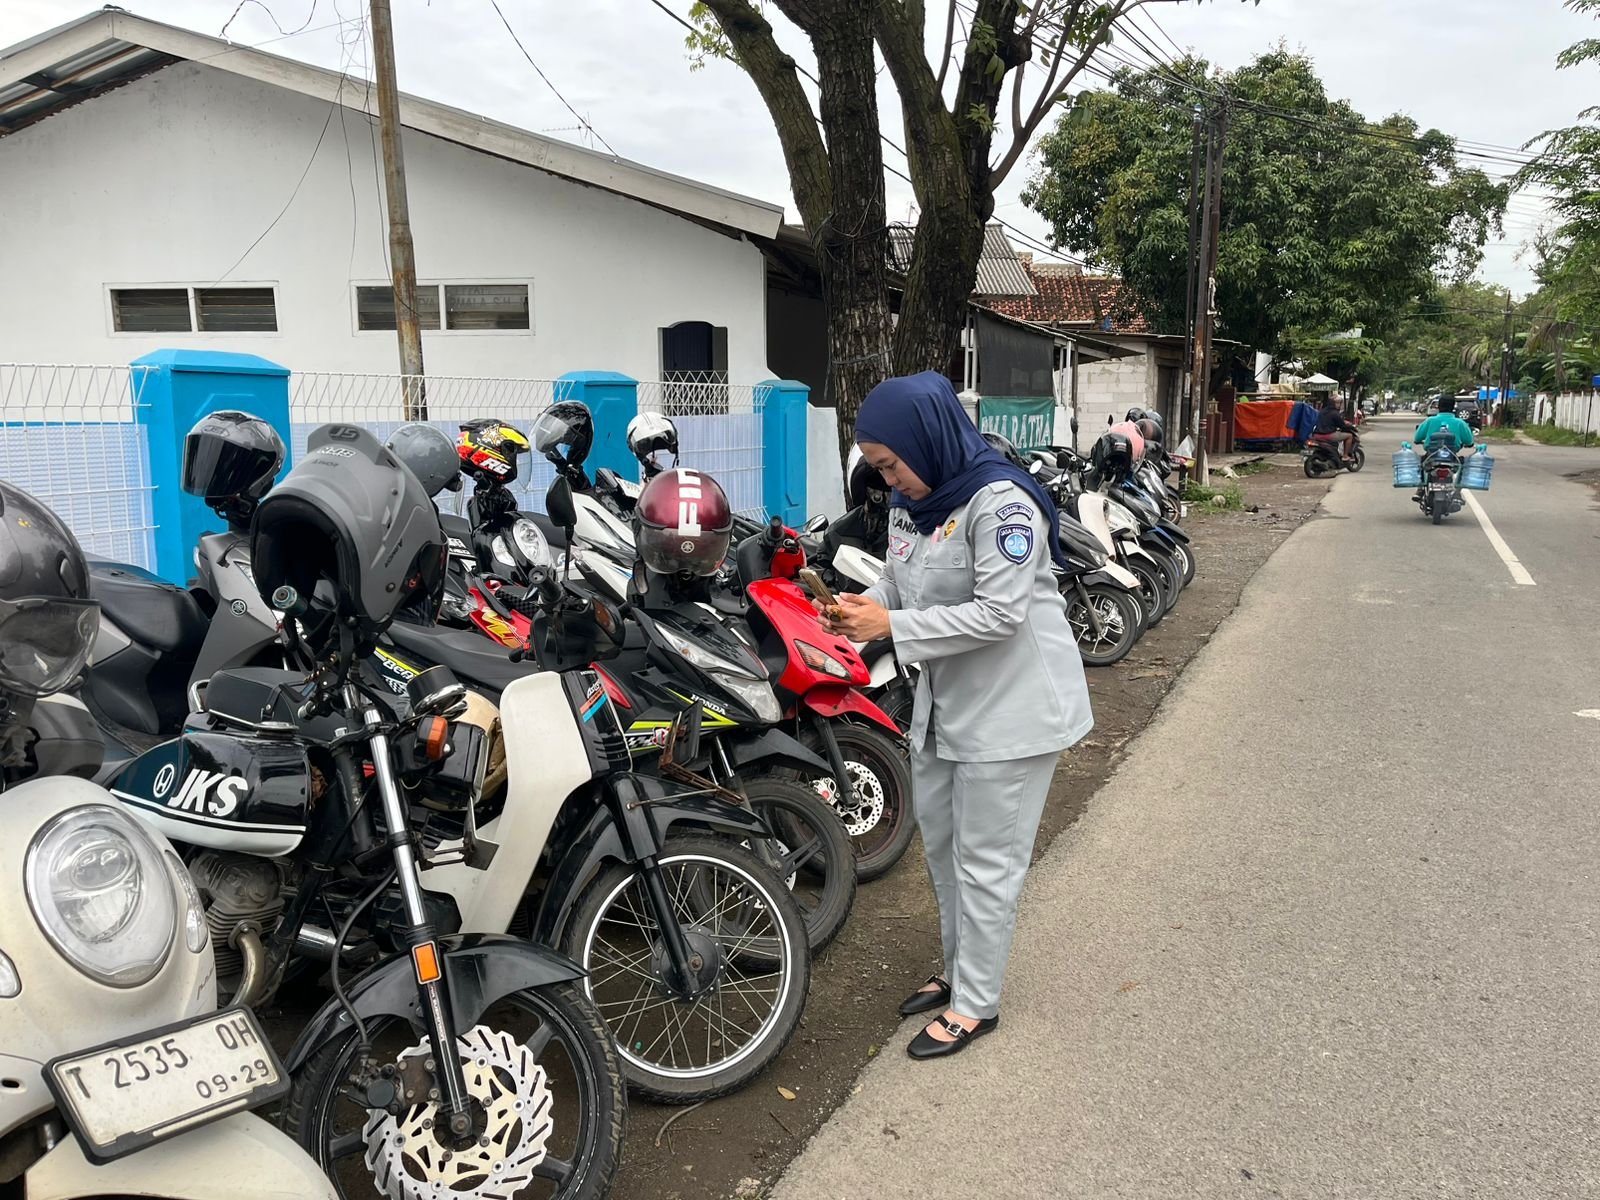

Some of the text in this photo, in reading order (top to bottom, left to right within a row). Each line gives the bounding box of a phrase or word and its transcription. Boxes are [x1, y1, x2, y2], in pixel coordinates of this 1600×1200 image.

[167, 768, 249, 817] JKS
[65, 1066, 91, 1099] T
[104, 1038, 189, 1089] 2535
